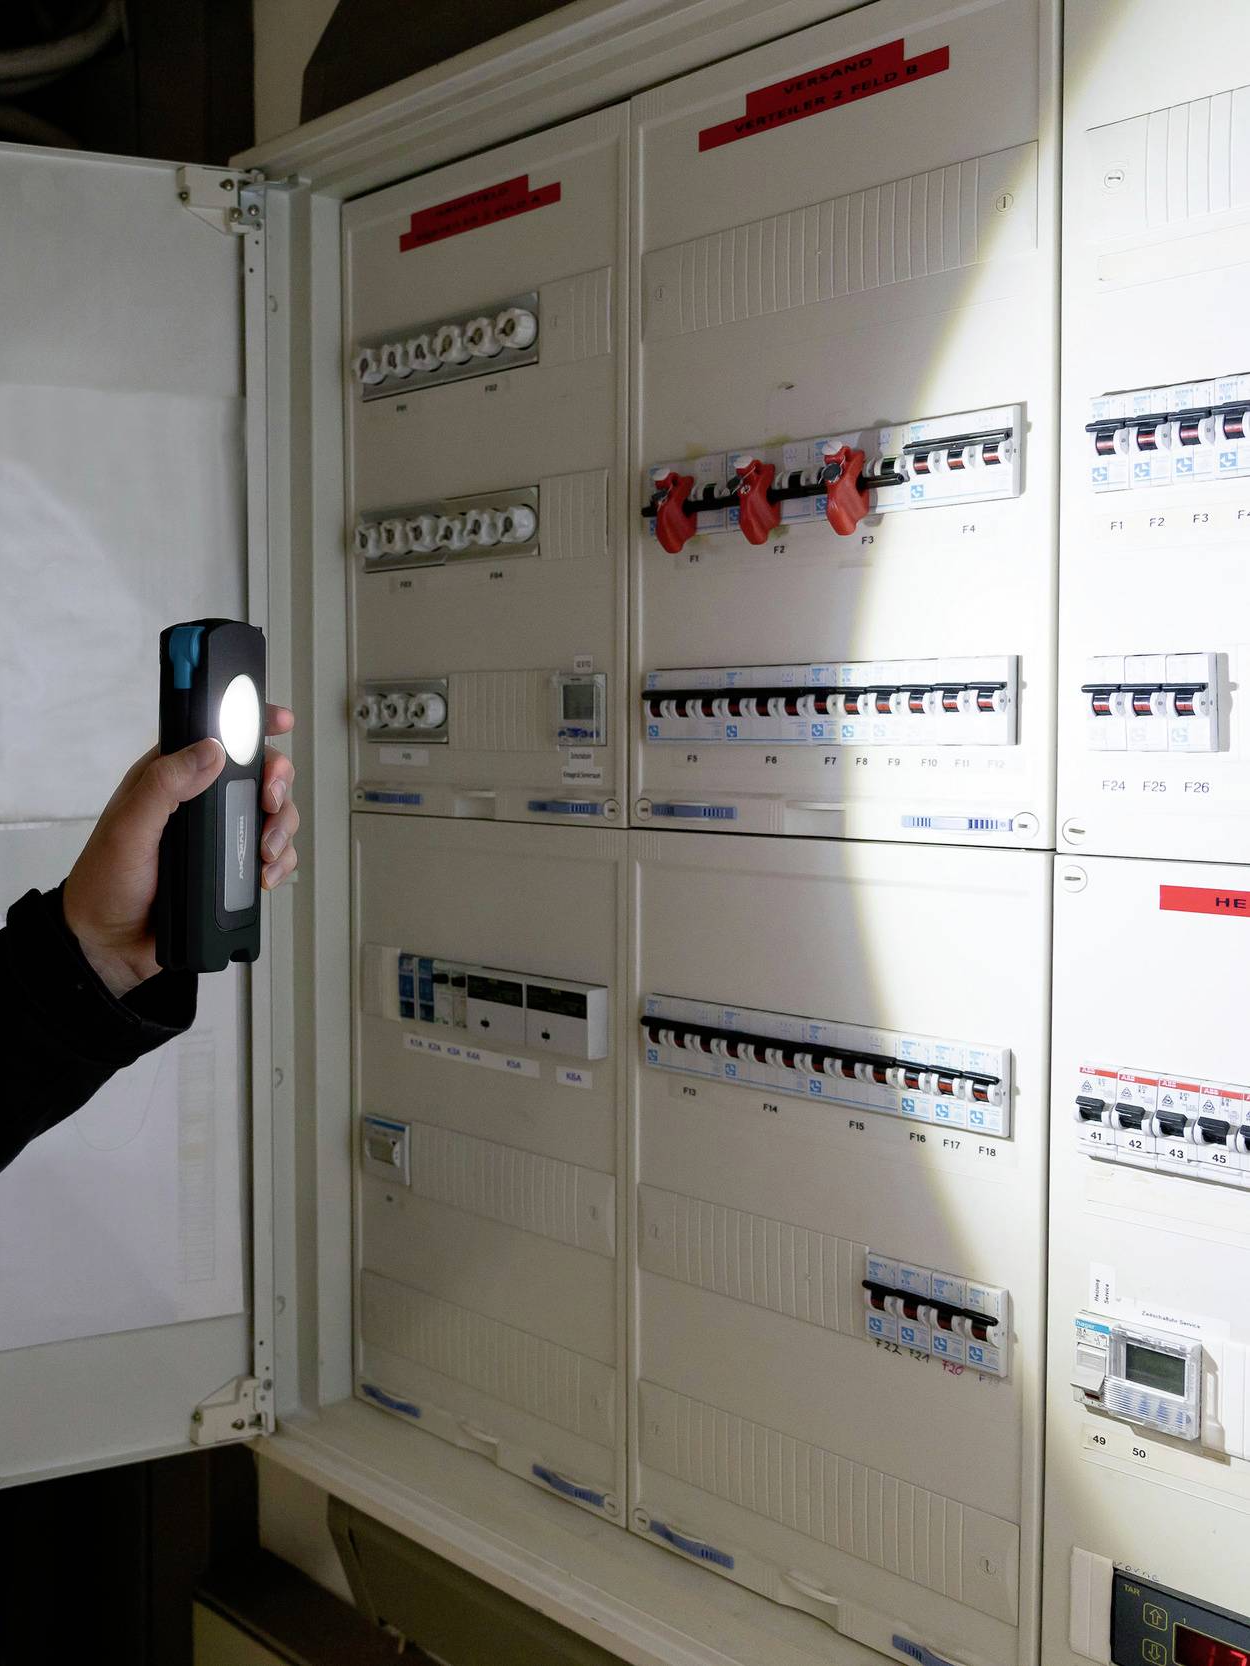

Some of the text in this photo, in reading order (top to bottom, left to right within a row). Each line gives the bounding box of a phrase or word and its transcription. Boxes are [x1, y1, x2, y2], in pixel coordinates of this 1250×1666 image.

[783, 58, 873, 94] VERSAND
[734, 64, 918, 133] VERTEILER 2 FELD B
[1150, 518, 1165, 527] F2
[1193, 514, 1209, 523] F3
[962, 525, 975, 533] F4
[1111, 521, 1123, 530] F1
[862, 536, 874, 544] F3
[774, 546, 785, 554] F2
[765, 756, 777, 764] F6
[825, 757, 836, 765] F7
[856, 758, 867, 766] F8
[888, 758, 900, 766] F9
[921, 759, 937, 767] F10
[1102, 780, 1125, 791] F24
[1143, 781, 1167, 792] F25
[1184, 782, 1210, 793] F26
[1216, 897, 1247, 909] HE
[683, 1087, 696, 1096] F13
[763, 1104, 777, 1113] F14
[850, 1121, 864, 1131] F15
[910, 1133, 926, 1143] F16
[1090, 1132, 1102, 1140] 41
[943, 1139, 960, 1149] F17
[1129, 1140, 1141, 1149] 42
[979, 1146, 996, 1157] F18
[1169, 1149, 1183, 1158] 43
[1212, 1154, 1226, 1163] 45
[1093, 1435, 1106, 1445] 49
[1133, 1448, 1146, 1458] 50
